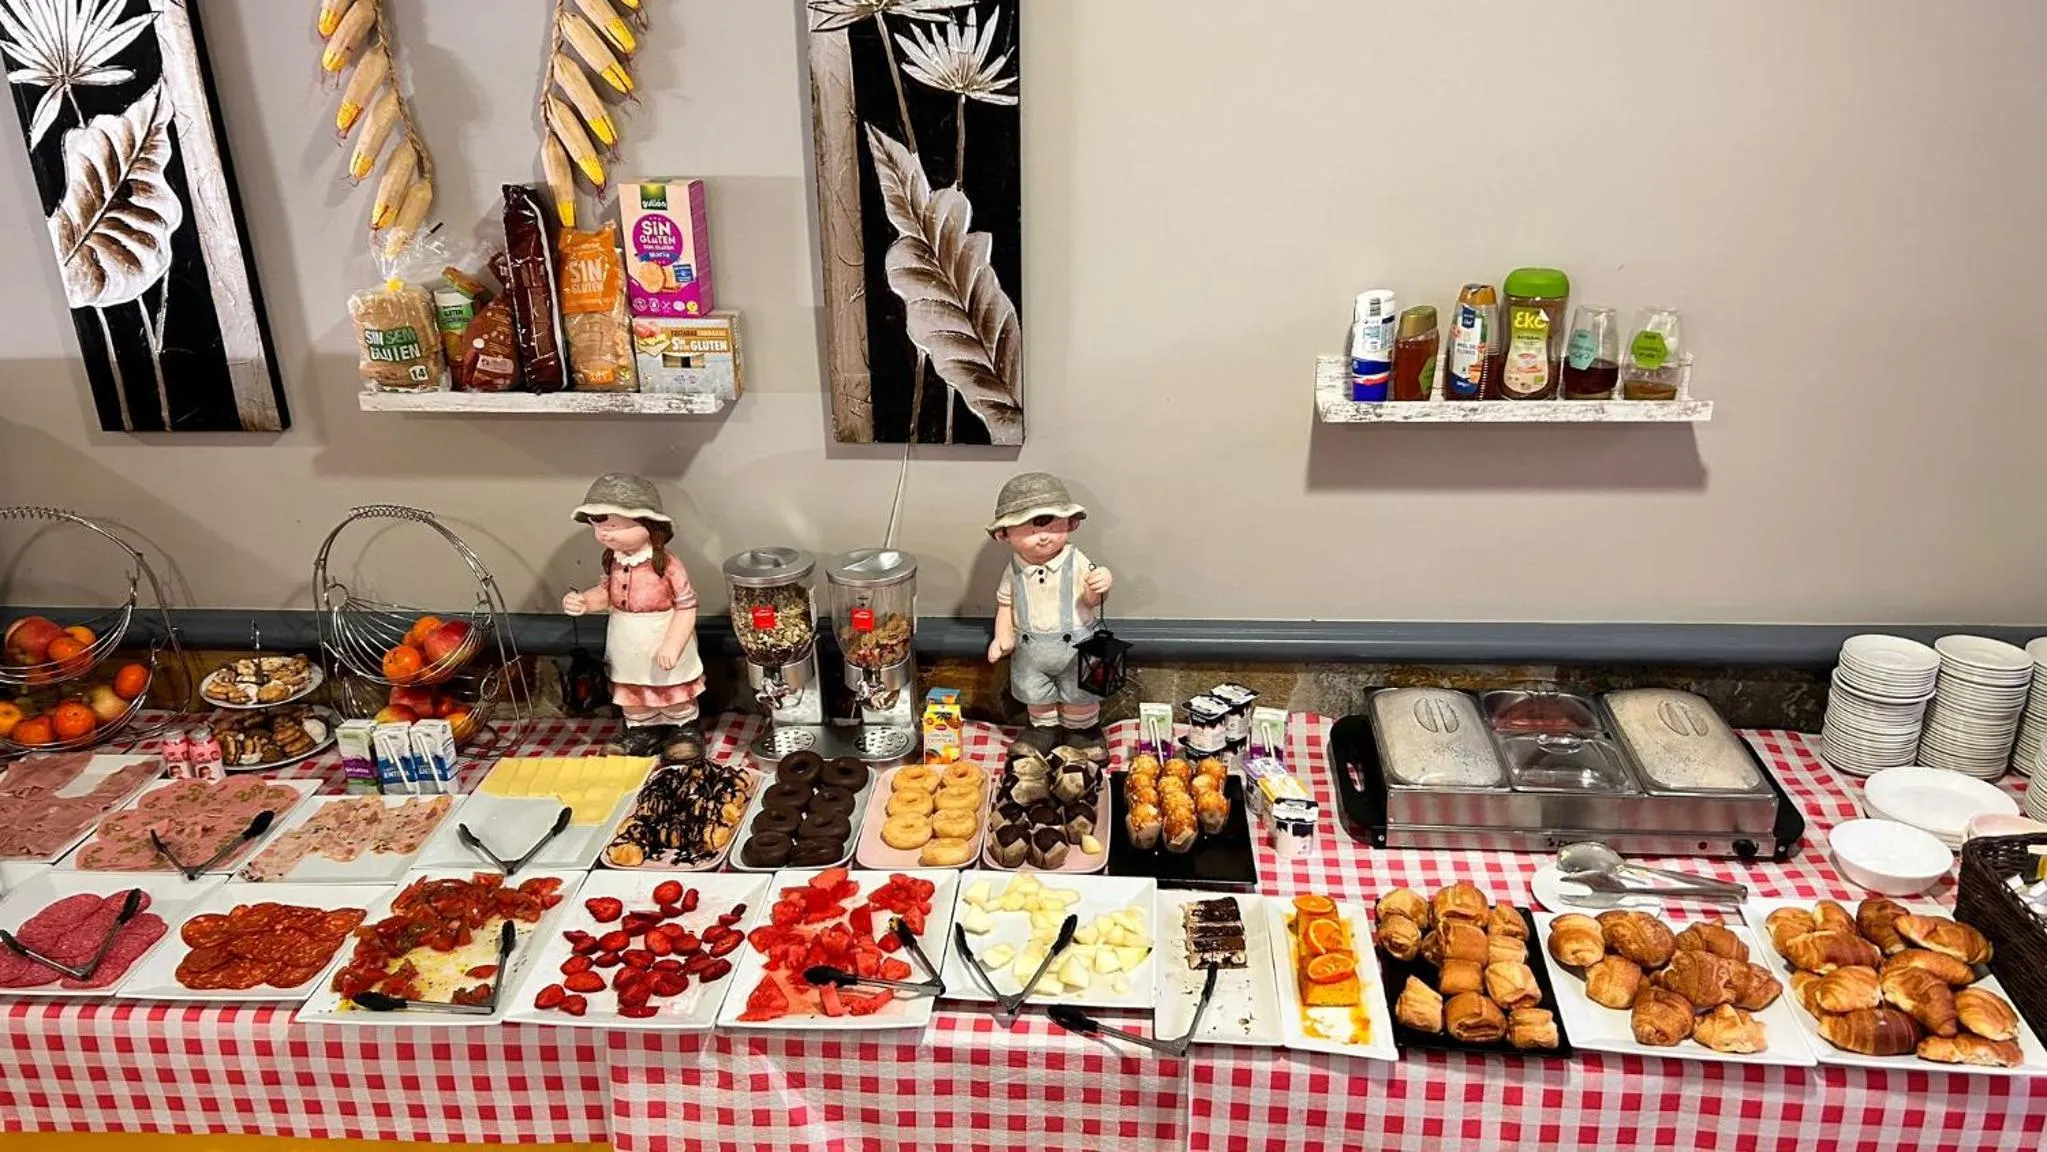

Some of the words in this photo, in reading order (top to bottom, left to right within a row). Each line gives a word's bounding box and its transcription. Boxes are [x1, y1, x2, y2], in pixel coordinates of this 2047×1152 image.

[569, 259, 603, 283] SIN
[365, 330, 384, 345] SIN
[385, 327, 416, 344] SEM
[690, 340, 727, 351] GLUTEN
[411, 368, 426, 379] 14
